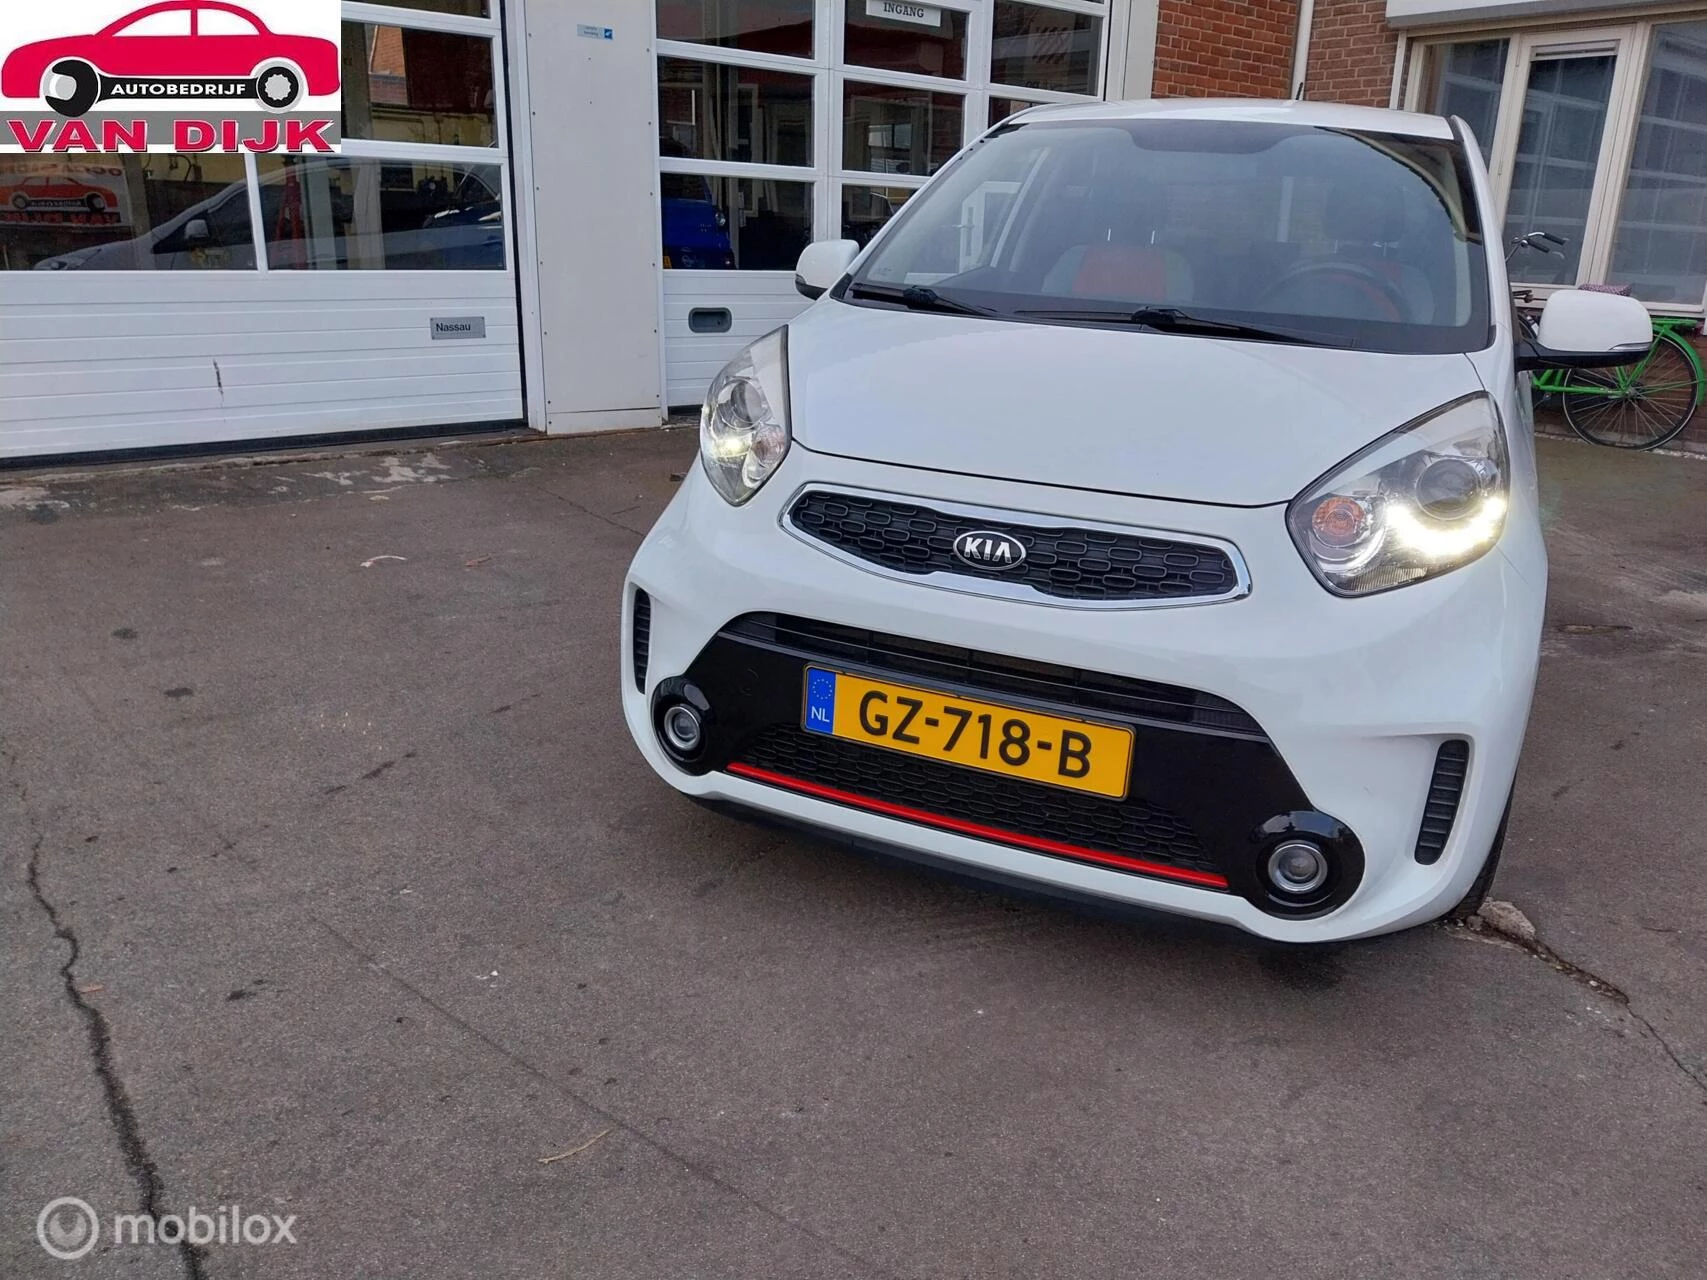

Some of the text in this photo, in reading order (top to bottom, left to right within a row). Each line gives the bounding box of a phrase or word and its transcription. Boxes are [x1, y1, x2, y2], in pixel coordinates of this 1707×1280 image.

[883, 2, 925, 18] INGANG
[435, 322, 471, 332] Nassau
[963, 536, 1012, 564] KIA
[811, 705, 830, 723] NL
[858, 690, 1092, 779] GZ-718-B
